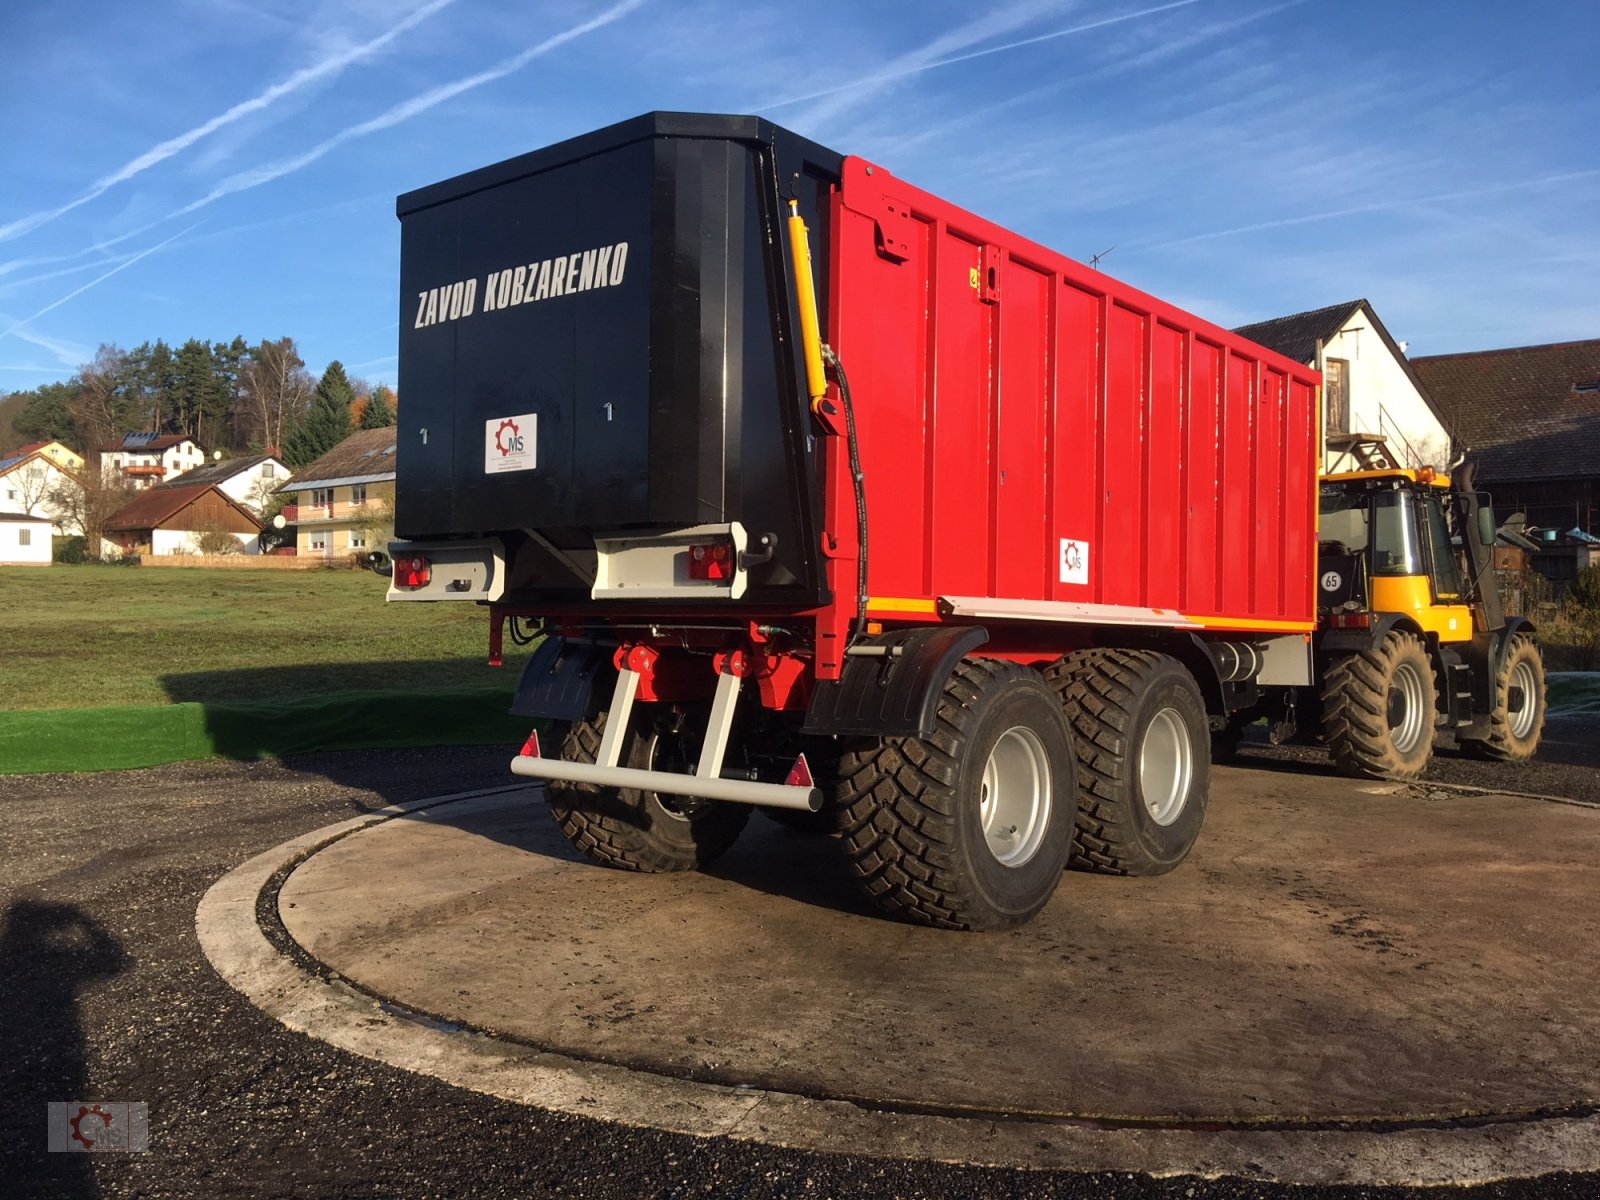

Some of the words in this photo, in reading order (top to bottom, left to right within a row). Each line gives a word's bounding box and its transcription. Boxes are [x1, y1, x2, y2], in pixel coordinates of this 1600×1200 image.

[414, 278, 478, 329] ZAVOD
[483, 241, 629, 313] KOBZARENKO
[1325, 576, 1337, 587] 65
